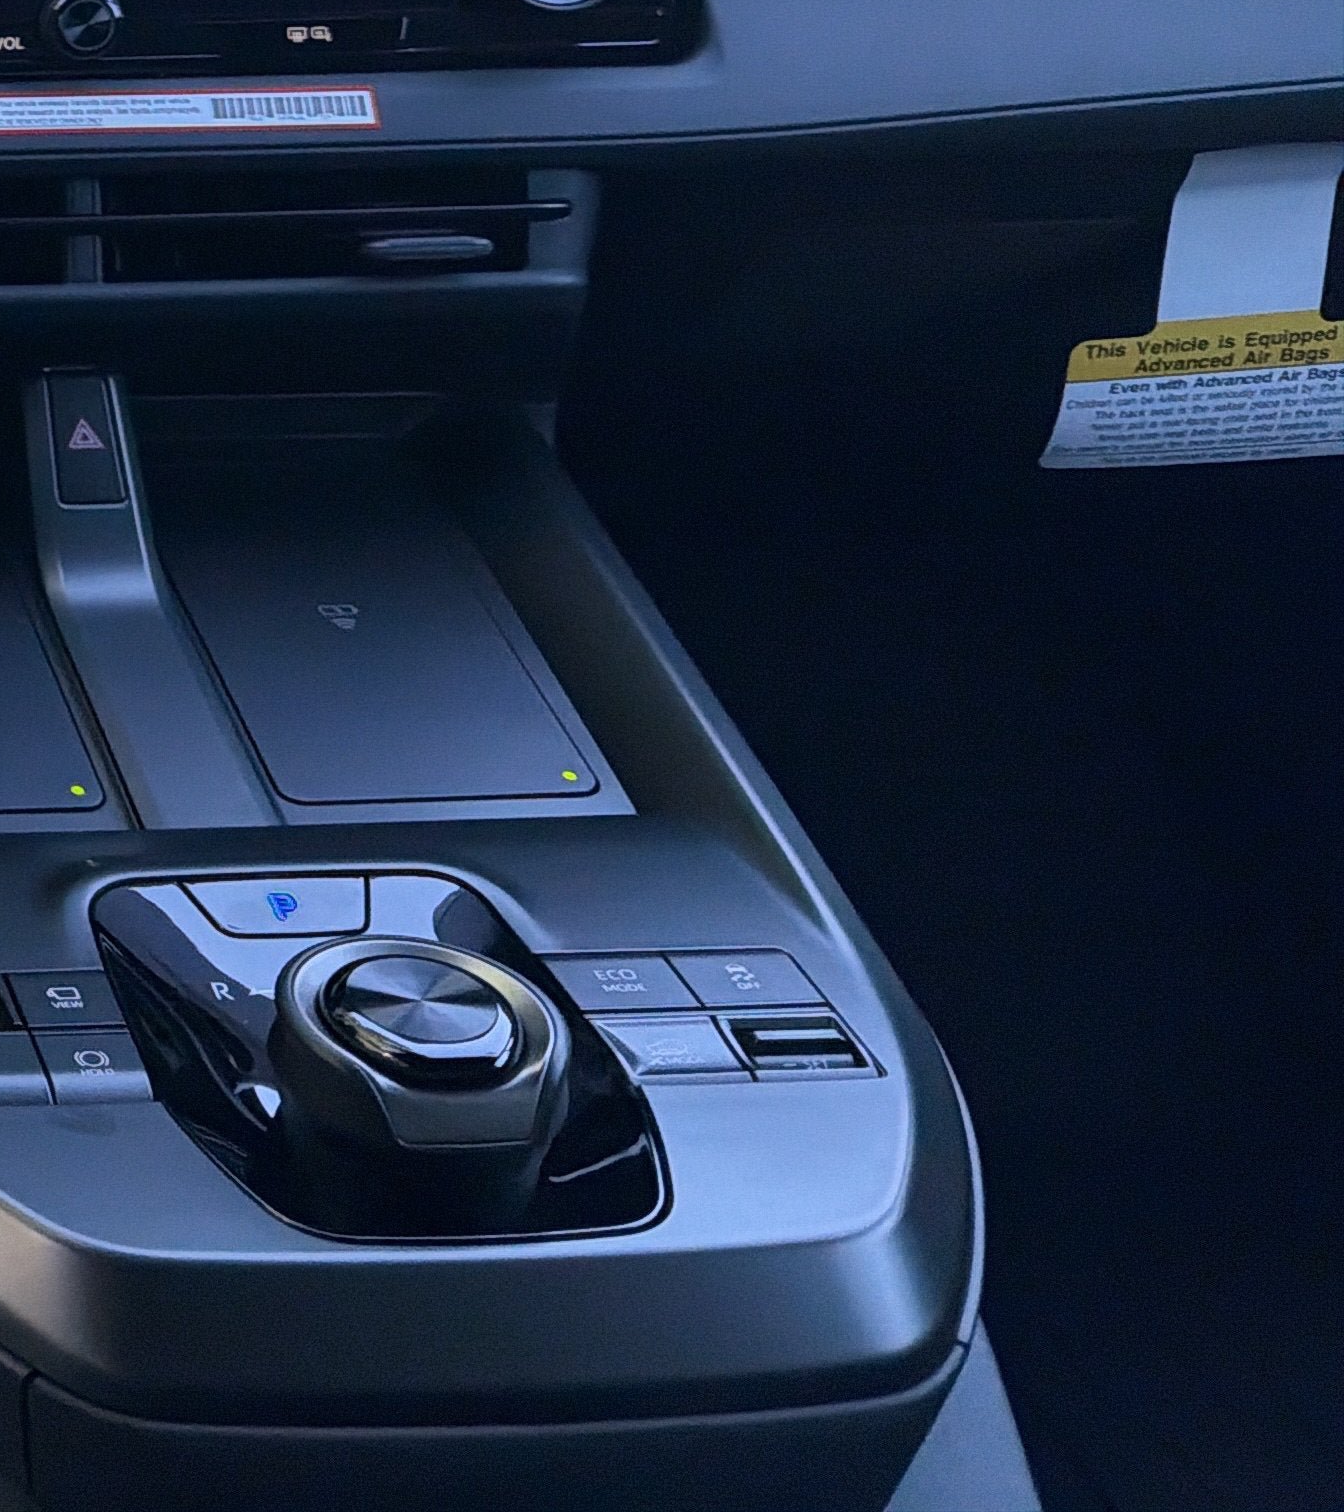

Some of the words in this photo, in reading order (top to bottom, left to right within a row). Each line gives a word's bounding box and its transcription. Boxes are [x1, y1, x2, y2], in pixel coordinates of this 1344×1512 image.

[1085, 342, 1126, 361] This
[1136, 336, 1209, 356] Vehicle
[1218, 334, 1235, 349] is
[1245, 325, 1338, 350] Equipped
[1134, 354, 1233, 375] Advanced
[1242, 351, 1272, 366] Air
[1279, 348, 1330, 365] Bags
[1108, 382, 1151, 395] Even
[1193, 372, 1272, 388] Advanced
[1278, 368, 1301, 383] Air
[592, 968, 638, 981] ECO
[211, 982, 235, 1001] R
[51, 999, 84, 1009] VIEW
